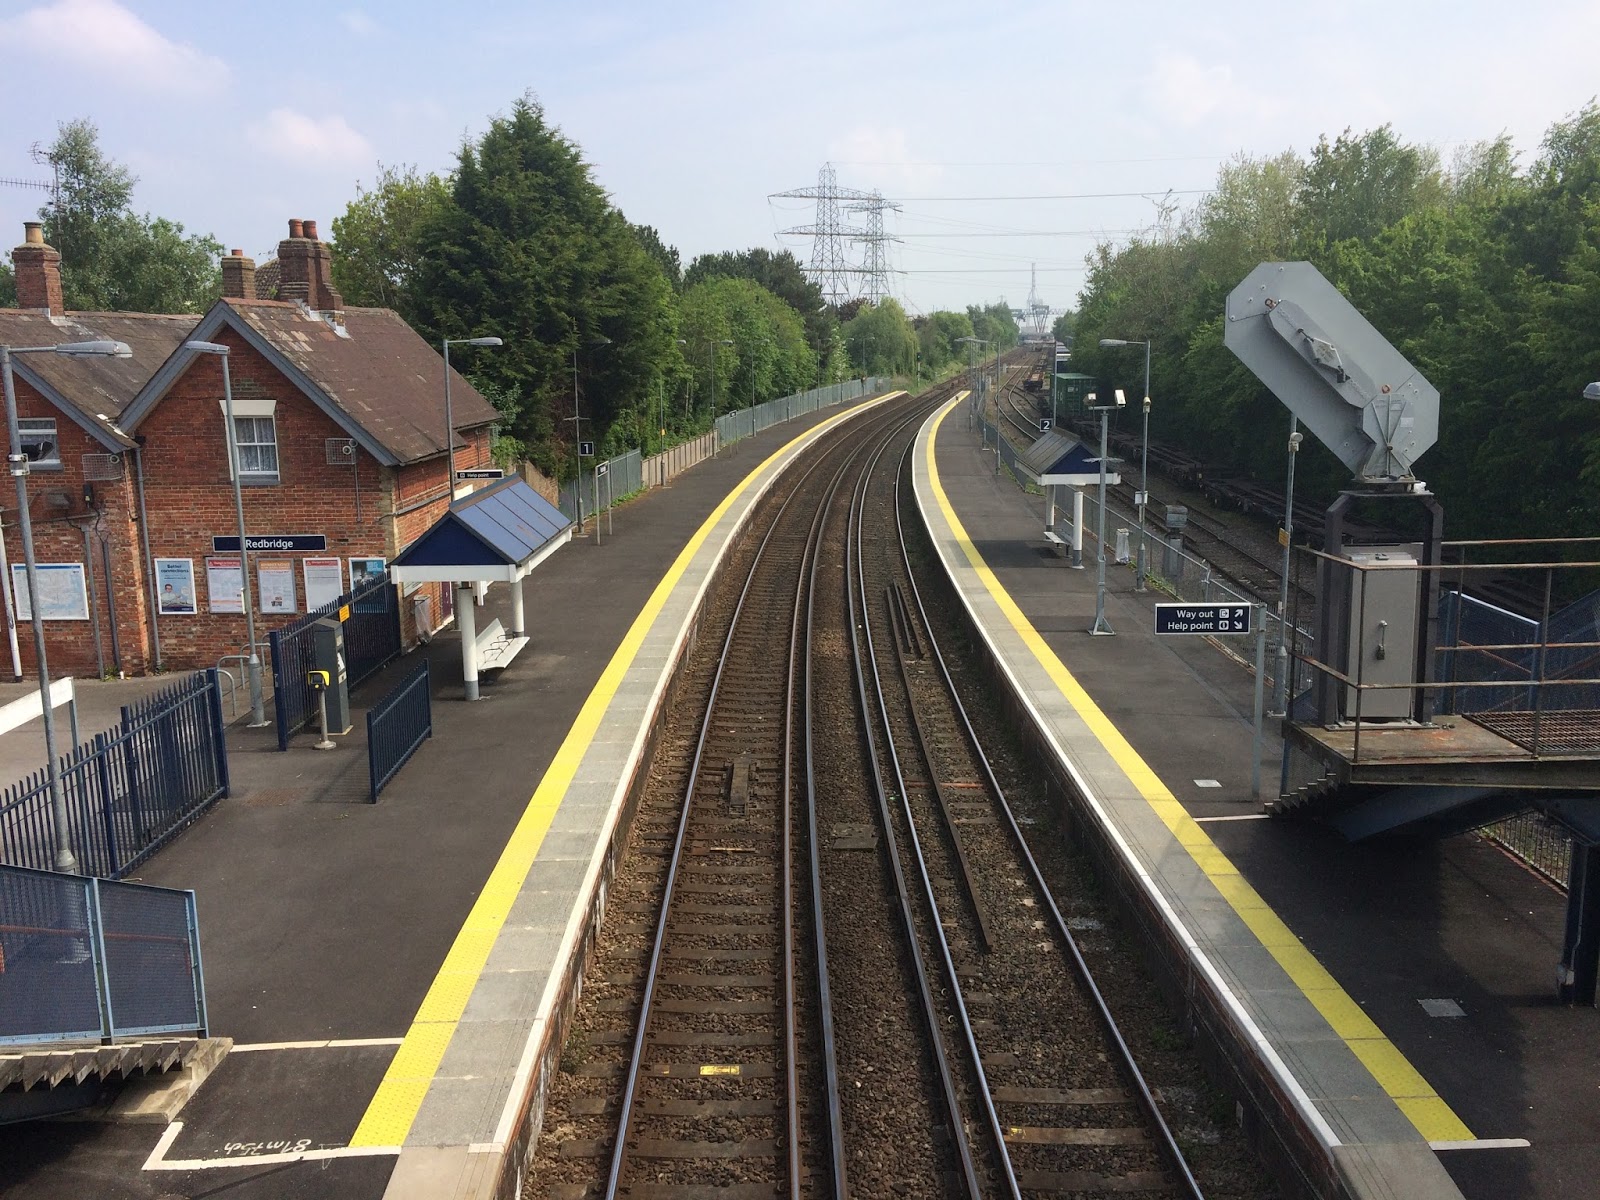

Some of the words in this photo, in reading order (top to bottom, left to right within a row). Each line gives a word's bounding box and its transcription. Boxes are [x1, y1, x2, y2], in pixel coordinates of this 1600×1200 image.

[1043, 420, 1050, 430] 2
[583, 443, 589, 454] 1
[245, 539, 294, 549] Redbridge
[1176, 609, 1197, 620] Way
[1198, 609, 1214, 618] out
[1167, 621, 1188, 631] Help
[1190, 621, 1214, 631] point
